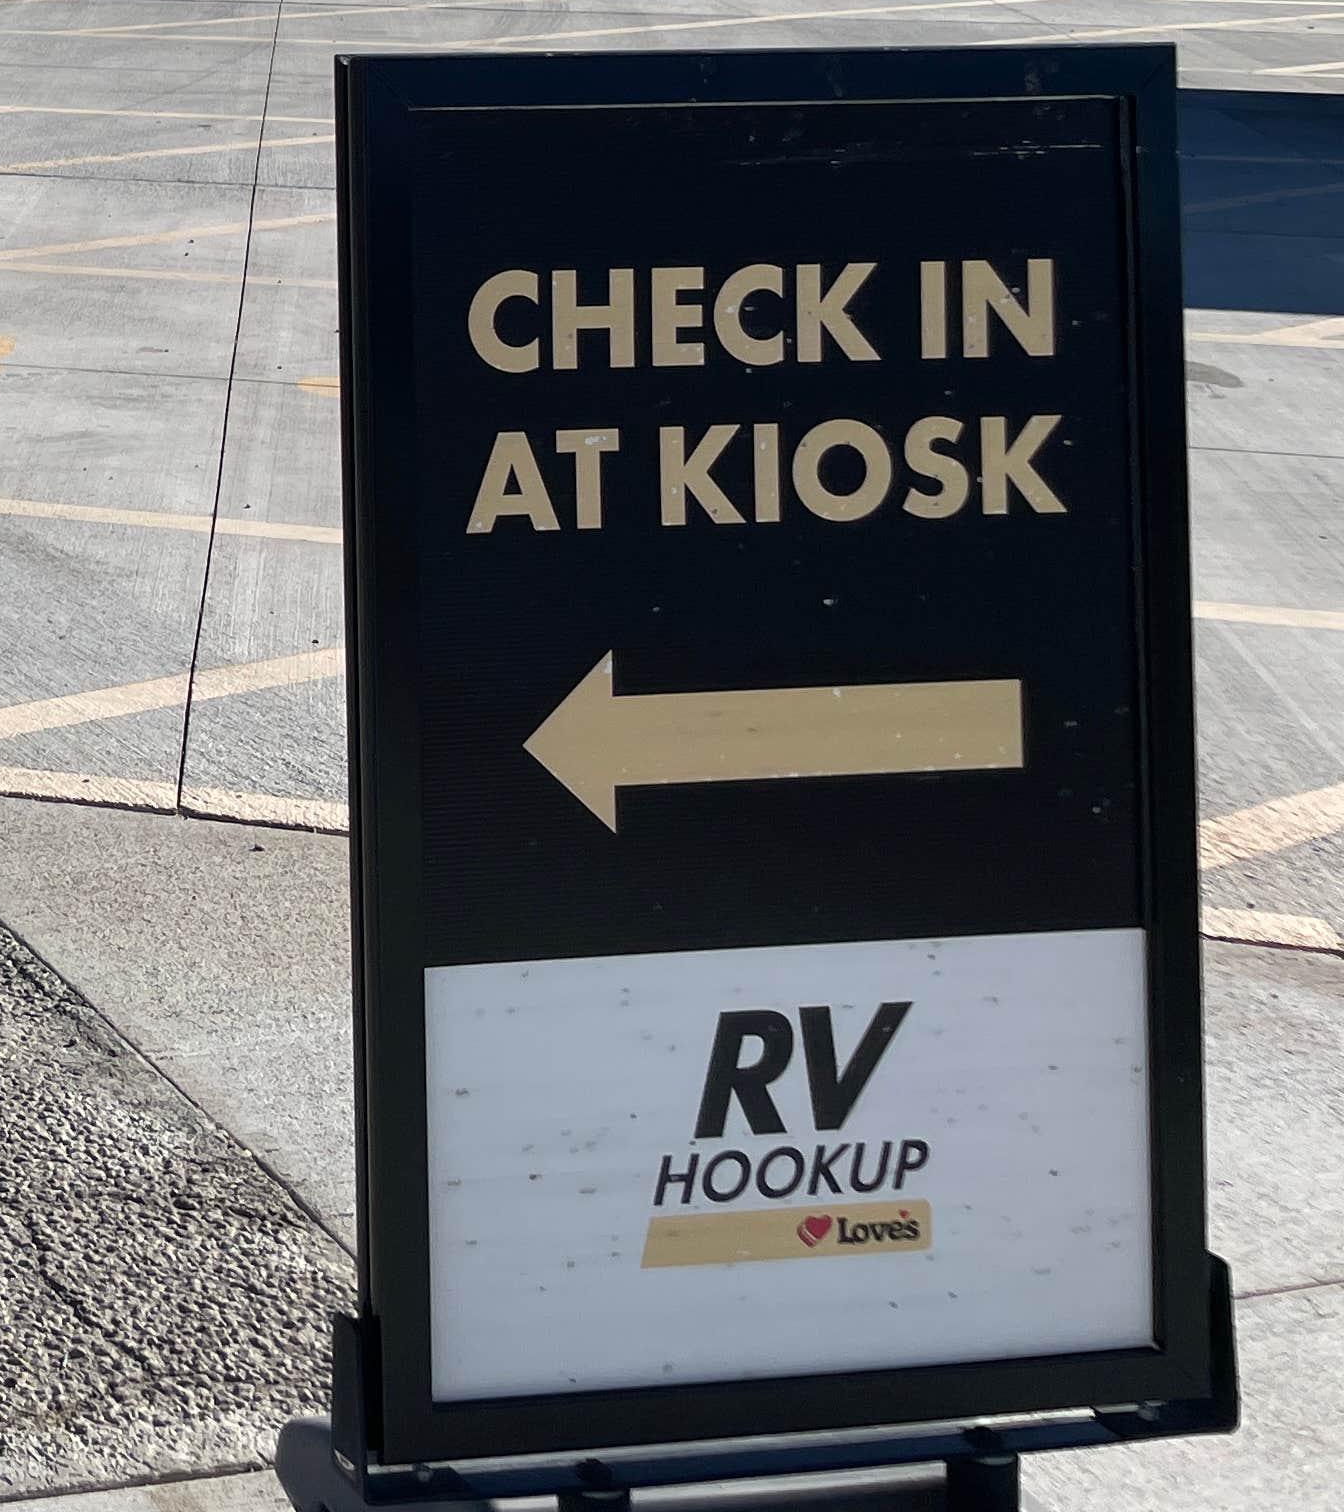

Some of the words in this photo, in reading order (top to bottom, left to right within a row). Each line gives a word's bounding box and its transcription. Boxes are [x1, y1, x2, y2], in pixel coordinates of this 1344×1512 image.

[468, 262, 882, 373] CHECK
[920, 258, 1055, 360] IN
[466, 428, 620, 534] AT
[659, 414, 1068, 526] KIOSK
[694, 1001, 914, 1139] RV
[653, 1139, 930, 1206] HOOKUP
[836, 1209, 920, 1245] Love's
